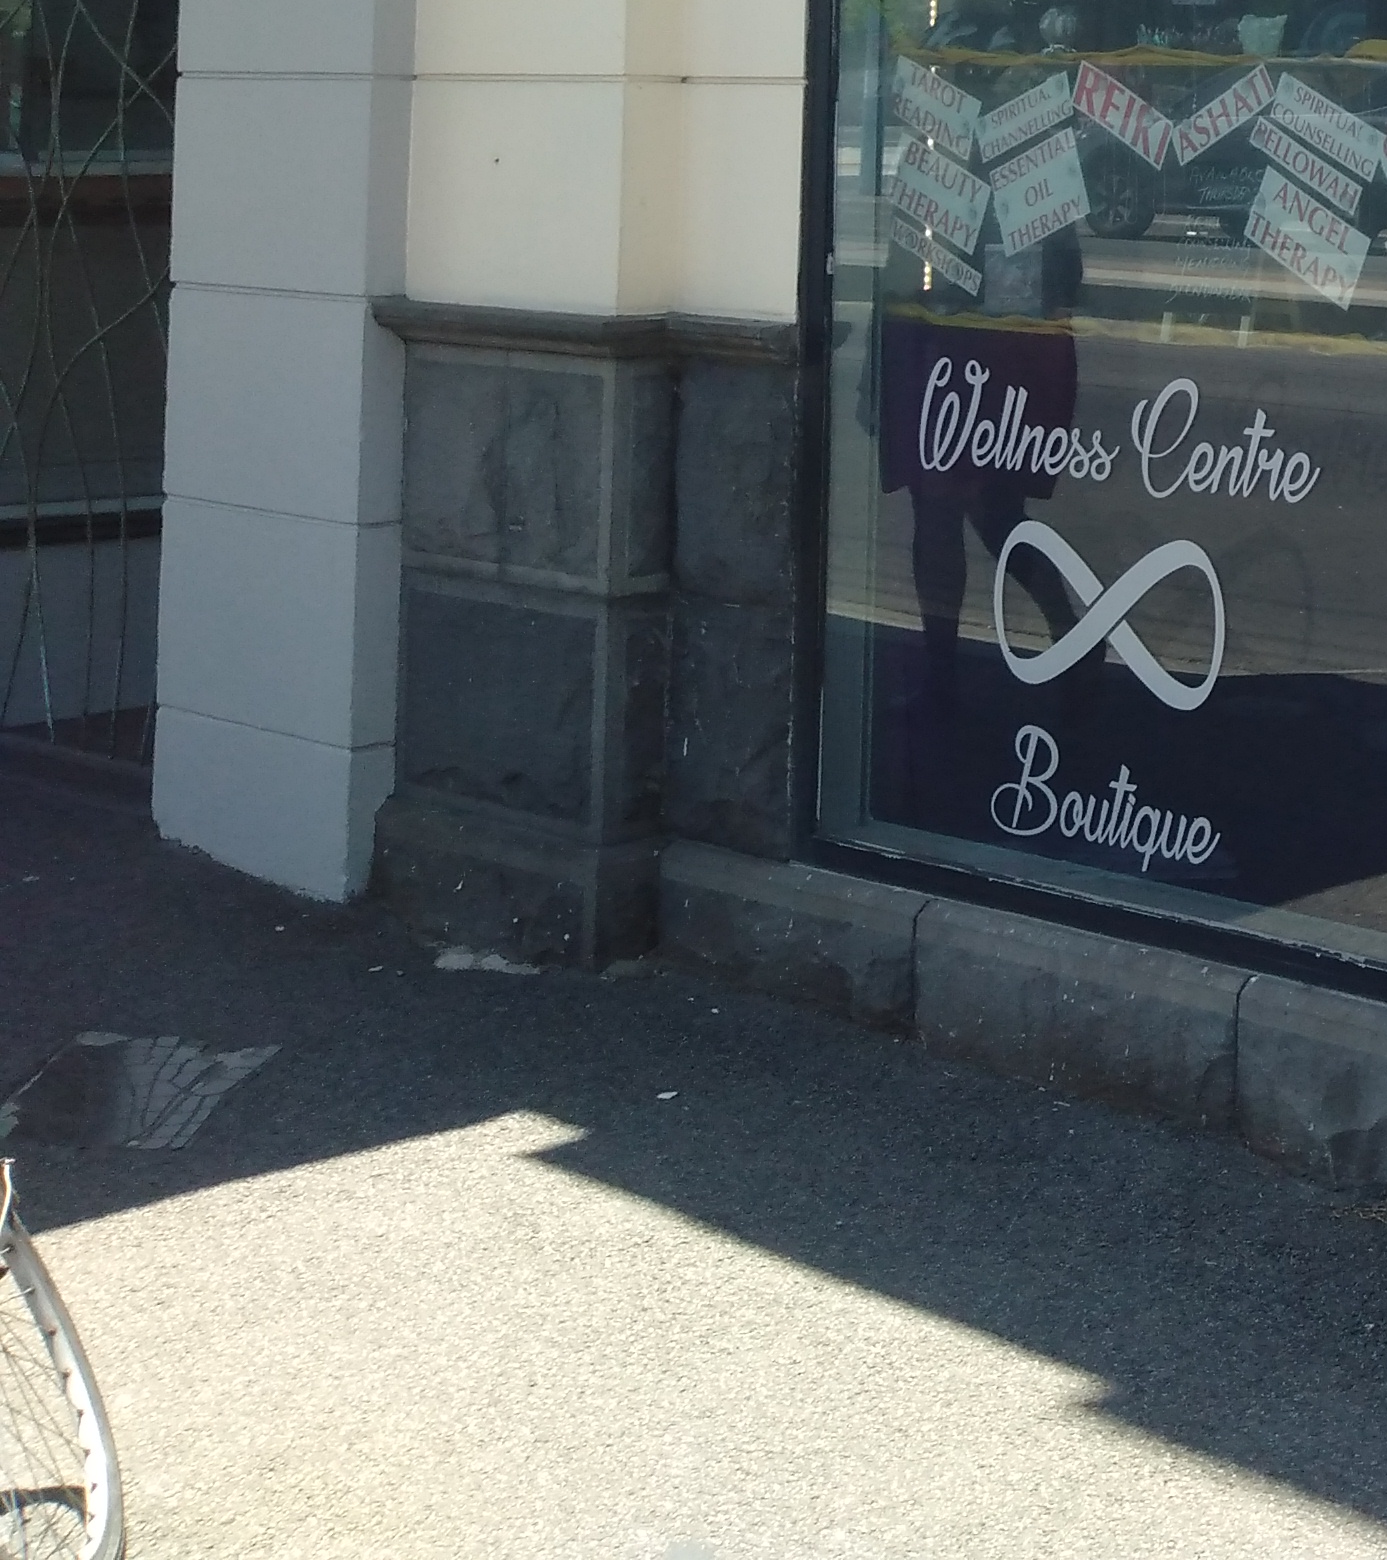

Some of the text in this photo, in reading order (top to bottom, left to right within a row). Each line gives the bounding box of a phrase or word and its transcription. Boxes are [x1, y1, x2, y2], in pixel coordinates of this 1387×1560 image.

[911, 64, 967, 114] TAROT
[1074, 64, 1170, 167] REIKI
[1180, 67, 1276, 161] ASHATI
[981, 99, 1073, 160] CHANNELLING
[992, 130, 1076, 191] ESSENTIAL
[1272, 101, 1374, 178] COUNSELLING
[904, 141, 984, 204] BEAUTY
[1024, 178, 1054, 208] OIL
[1253, 122, 1357, 212] PELLOWAH
[889, 175, 977, 249] THERAPY
[1008, 195, 1082, 252] THERAPY
[1273, 182, 1350, 256] ANGEL
[1252, 211, 1359, 302] THERAPY
[918, 356, 1321, 503] Wellness Centre
[990, 724, 1221, 872] Boutique
